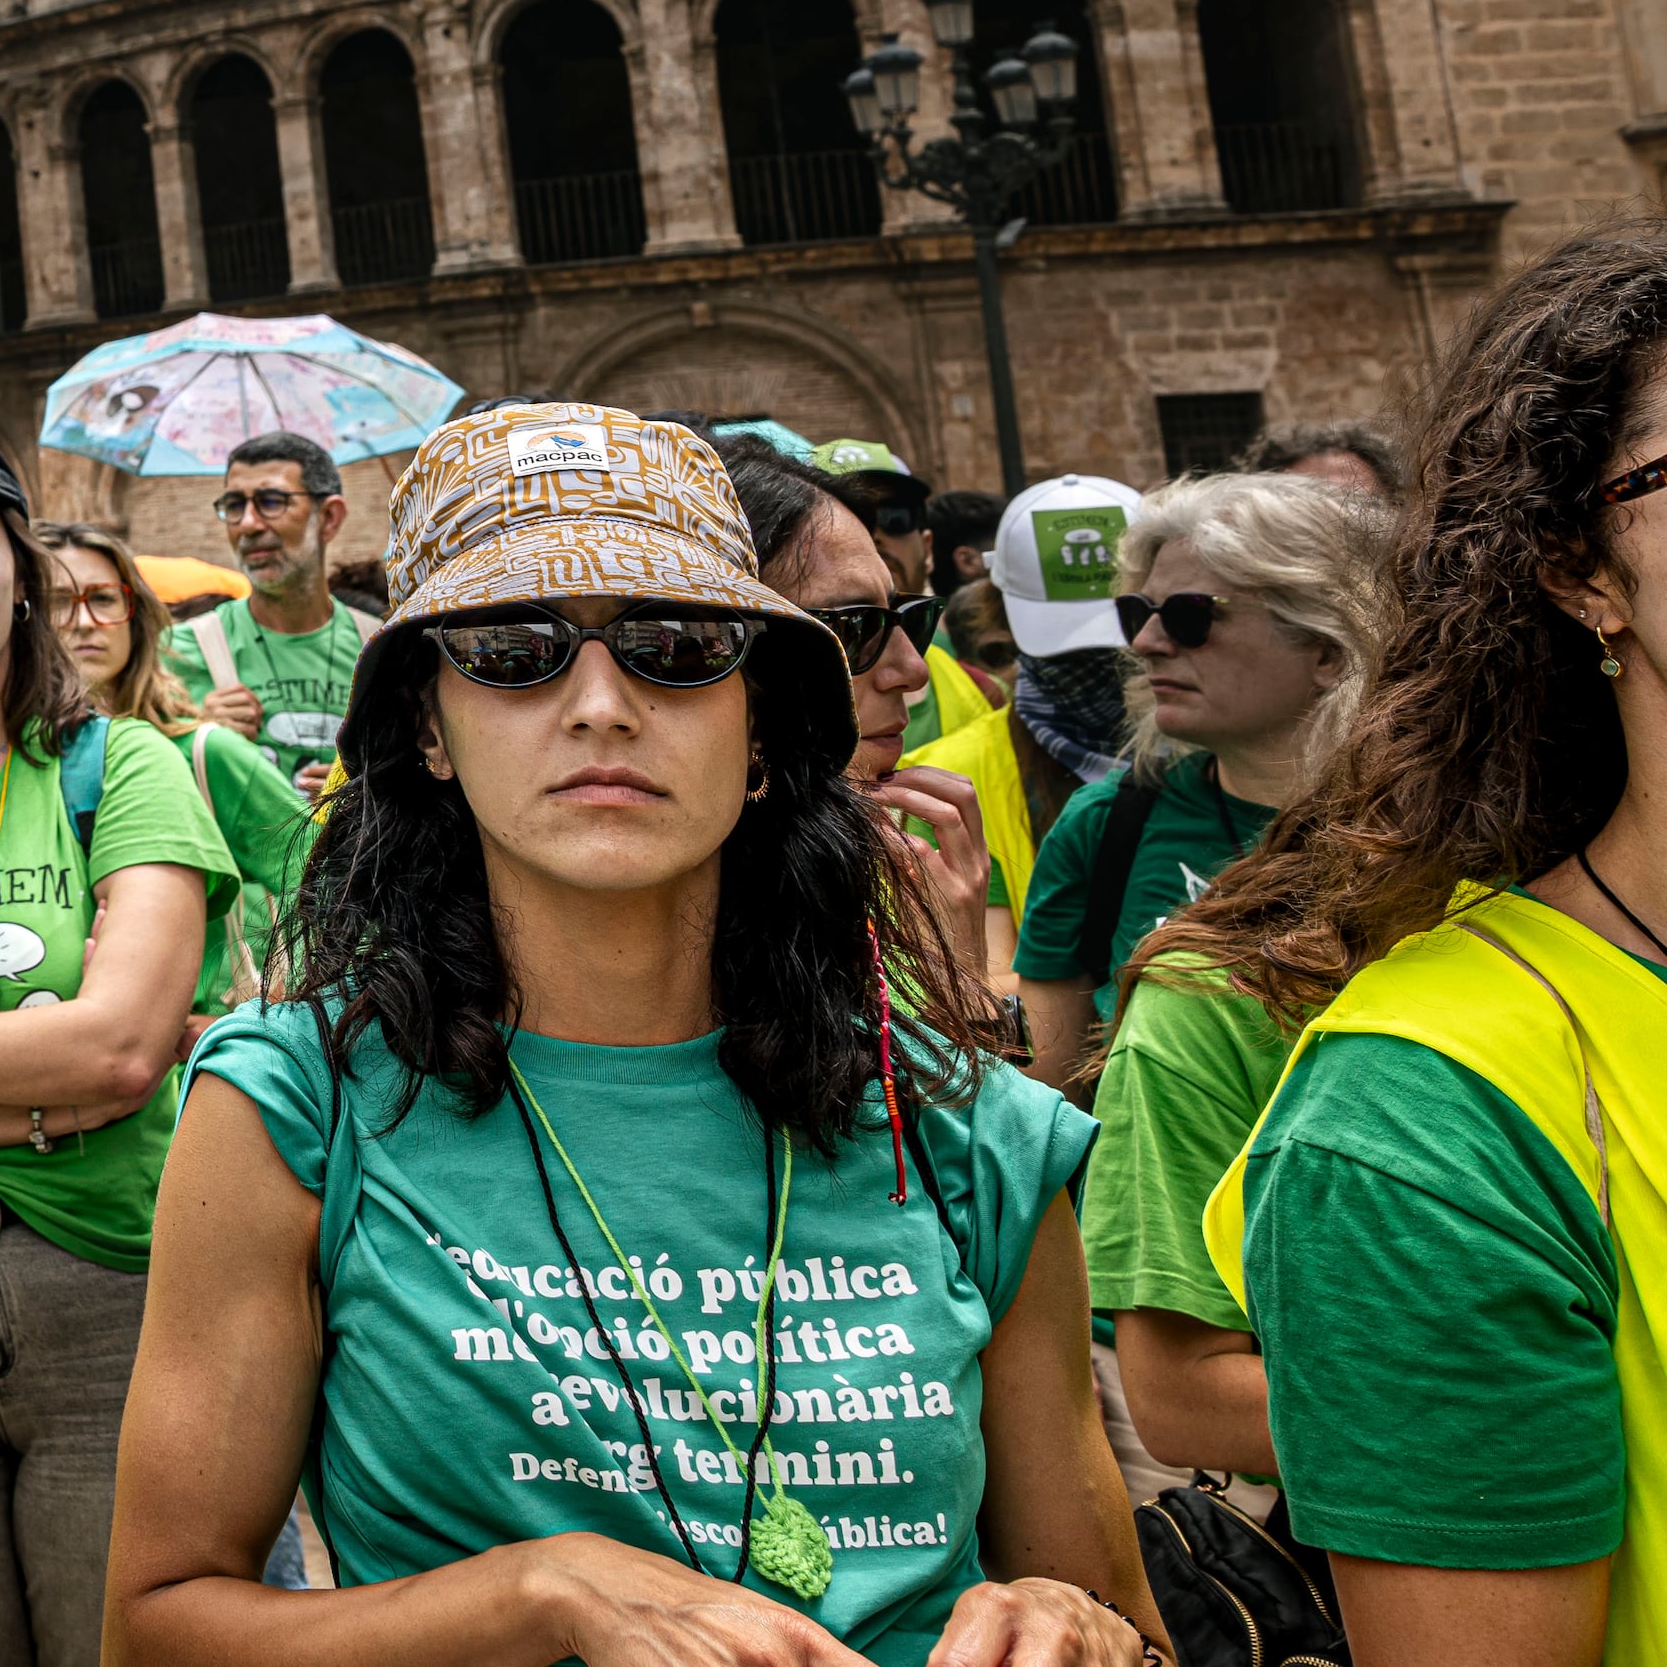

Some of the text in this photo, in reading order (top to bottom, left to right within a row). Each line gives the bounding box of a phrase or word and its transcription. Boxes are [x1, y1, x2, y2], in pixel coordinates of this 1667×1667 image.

[517, 451, 603, 467] macpac
[697, 1254, 919, 1315] pública
[672, 1436, 915, 1486] termini.
